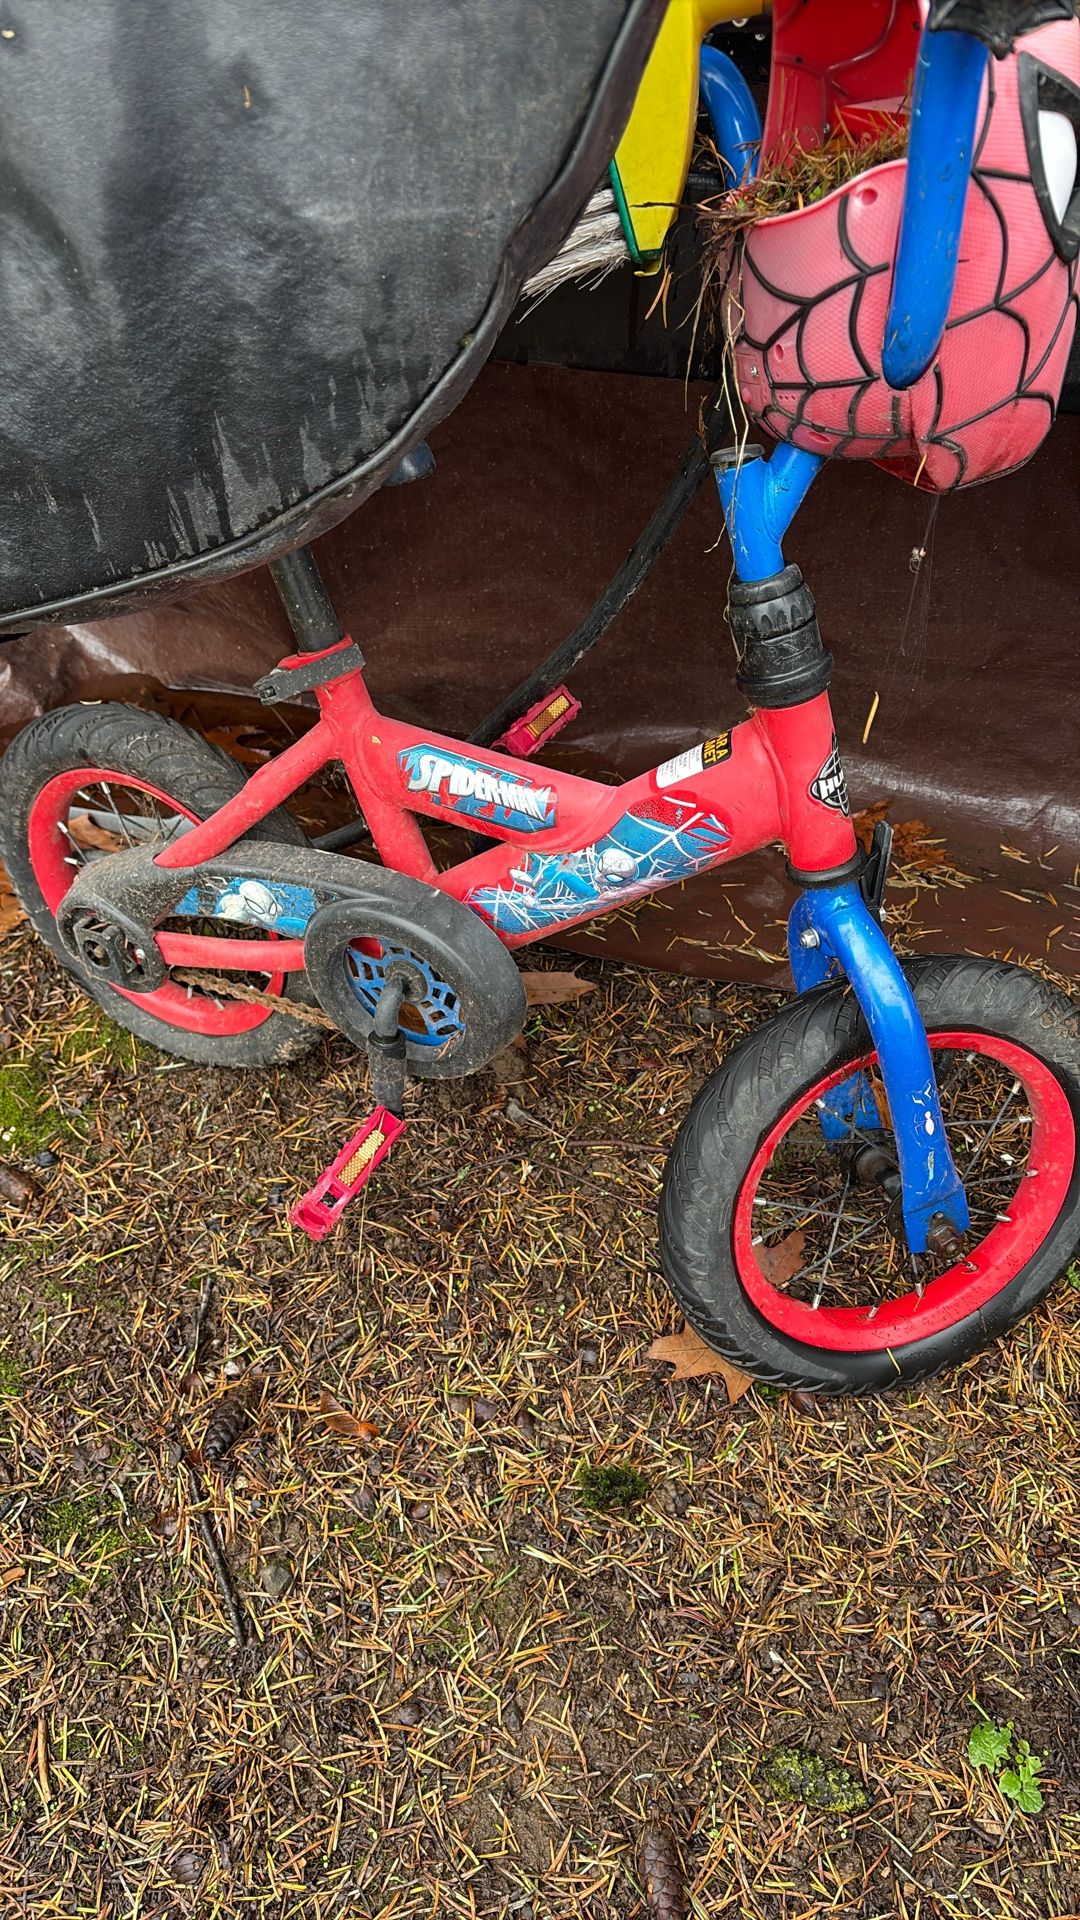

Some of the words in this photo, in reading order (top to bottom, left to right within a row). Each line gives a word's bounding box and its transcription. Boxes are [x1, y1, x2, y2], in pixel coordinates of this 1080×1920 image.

[715, 730, 729, 749] AR
[703, 738, 717, 764] MET
[716, 748, 729, 760] A
[817, 768, 845, 801] HU
